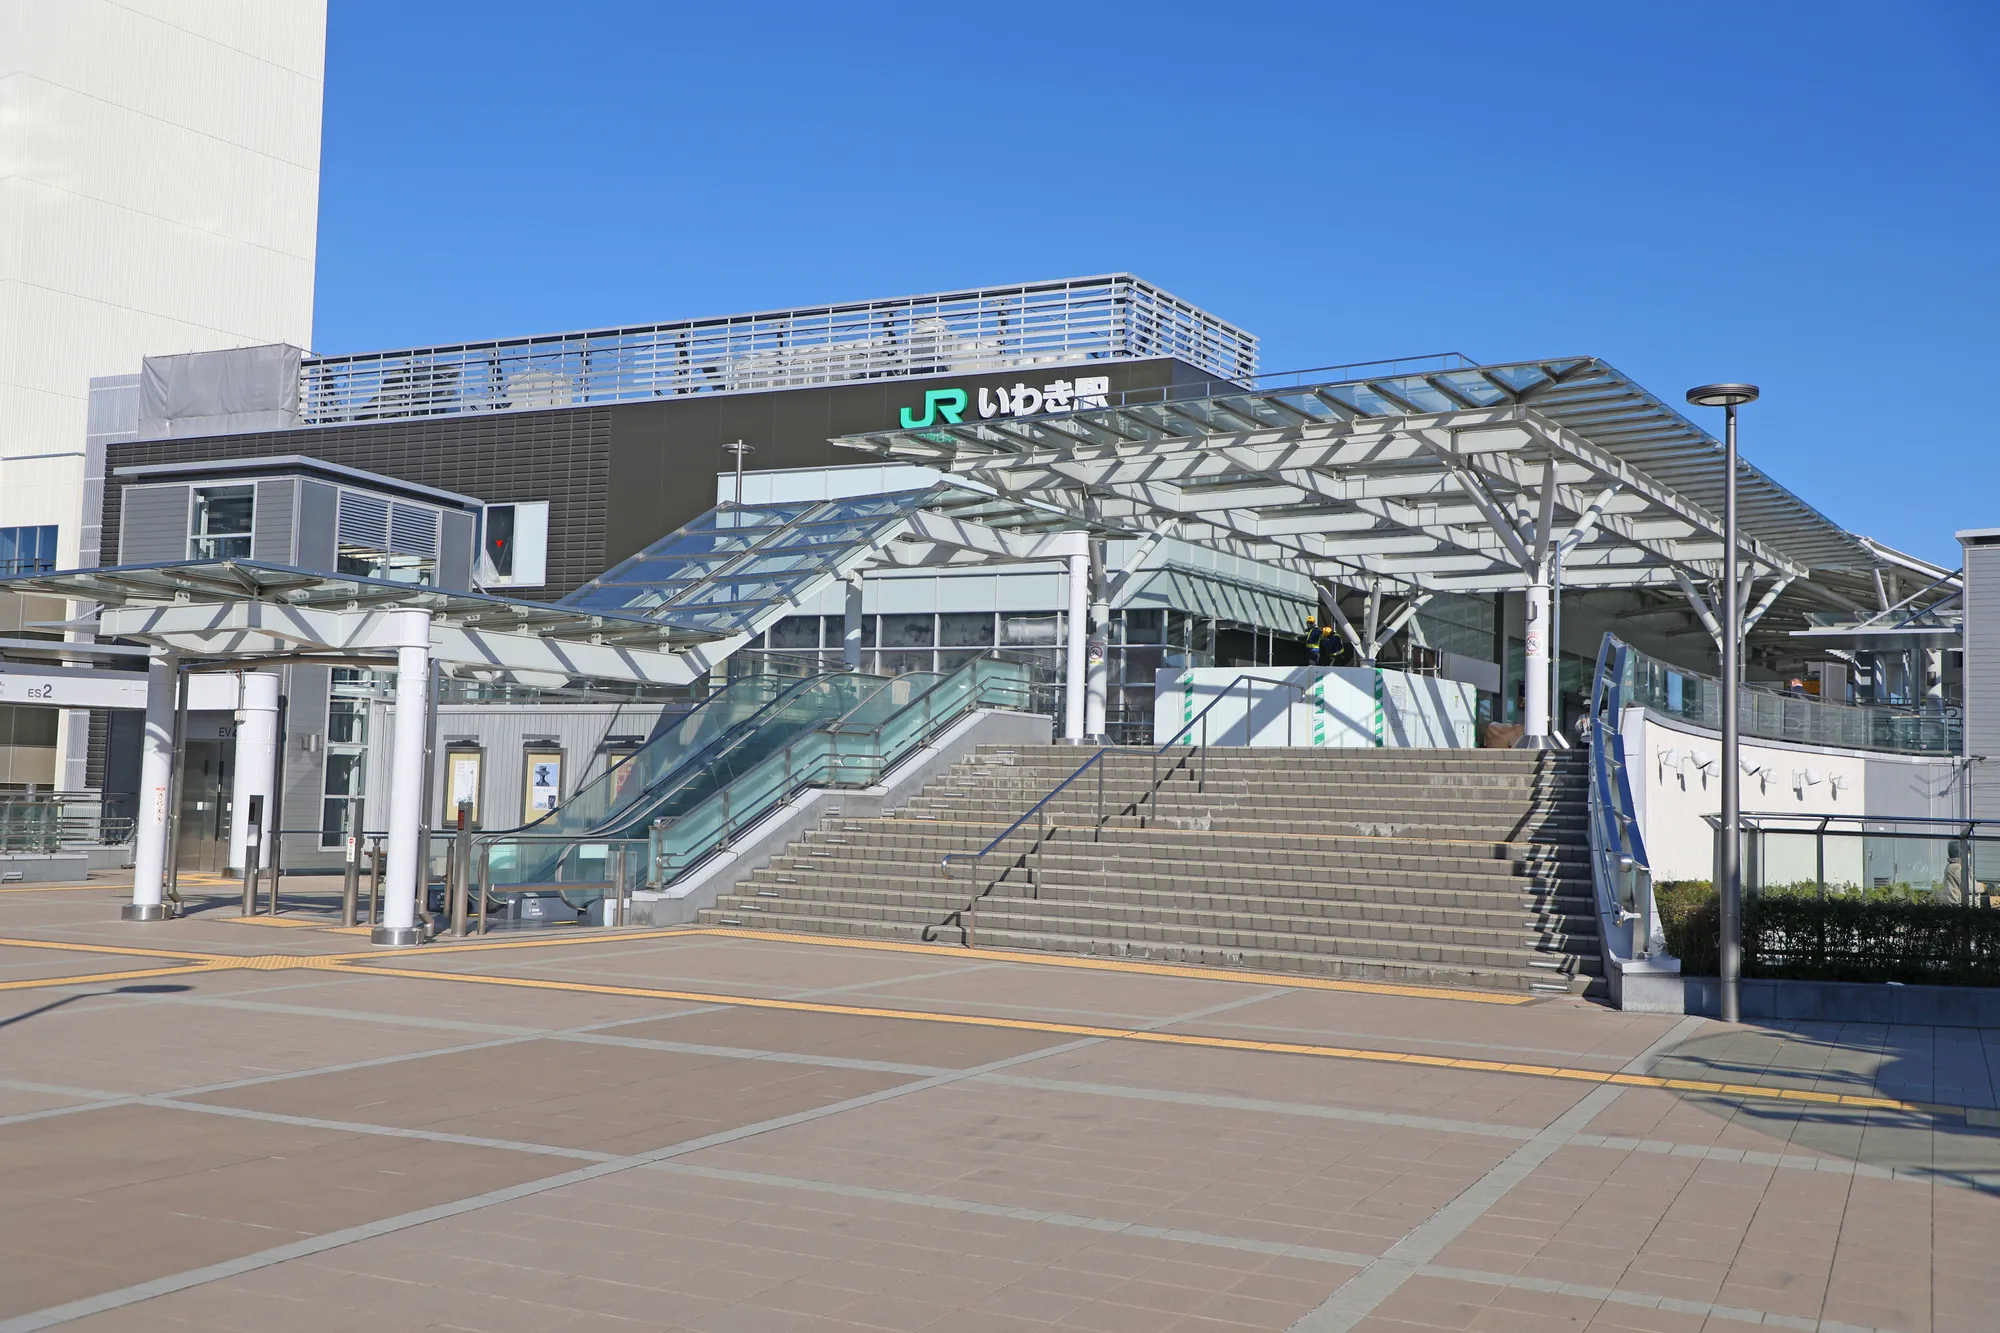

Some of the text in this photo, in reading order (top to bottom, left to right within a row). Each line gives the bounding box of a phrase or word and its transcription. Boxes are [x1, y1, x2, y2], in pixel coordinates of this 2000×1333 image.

[901, 376, 1109, 429] JR いわき駅
